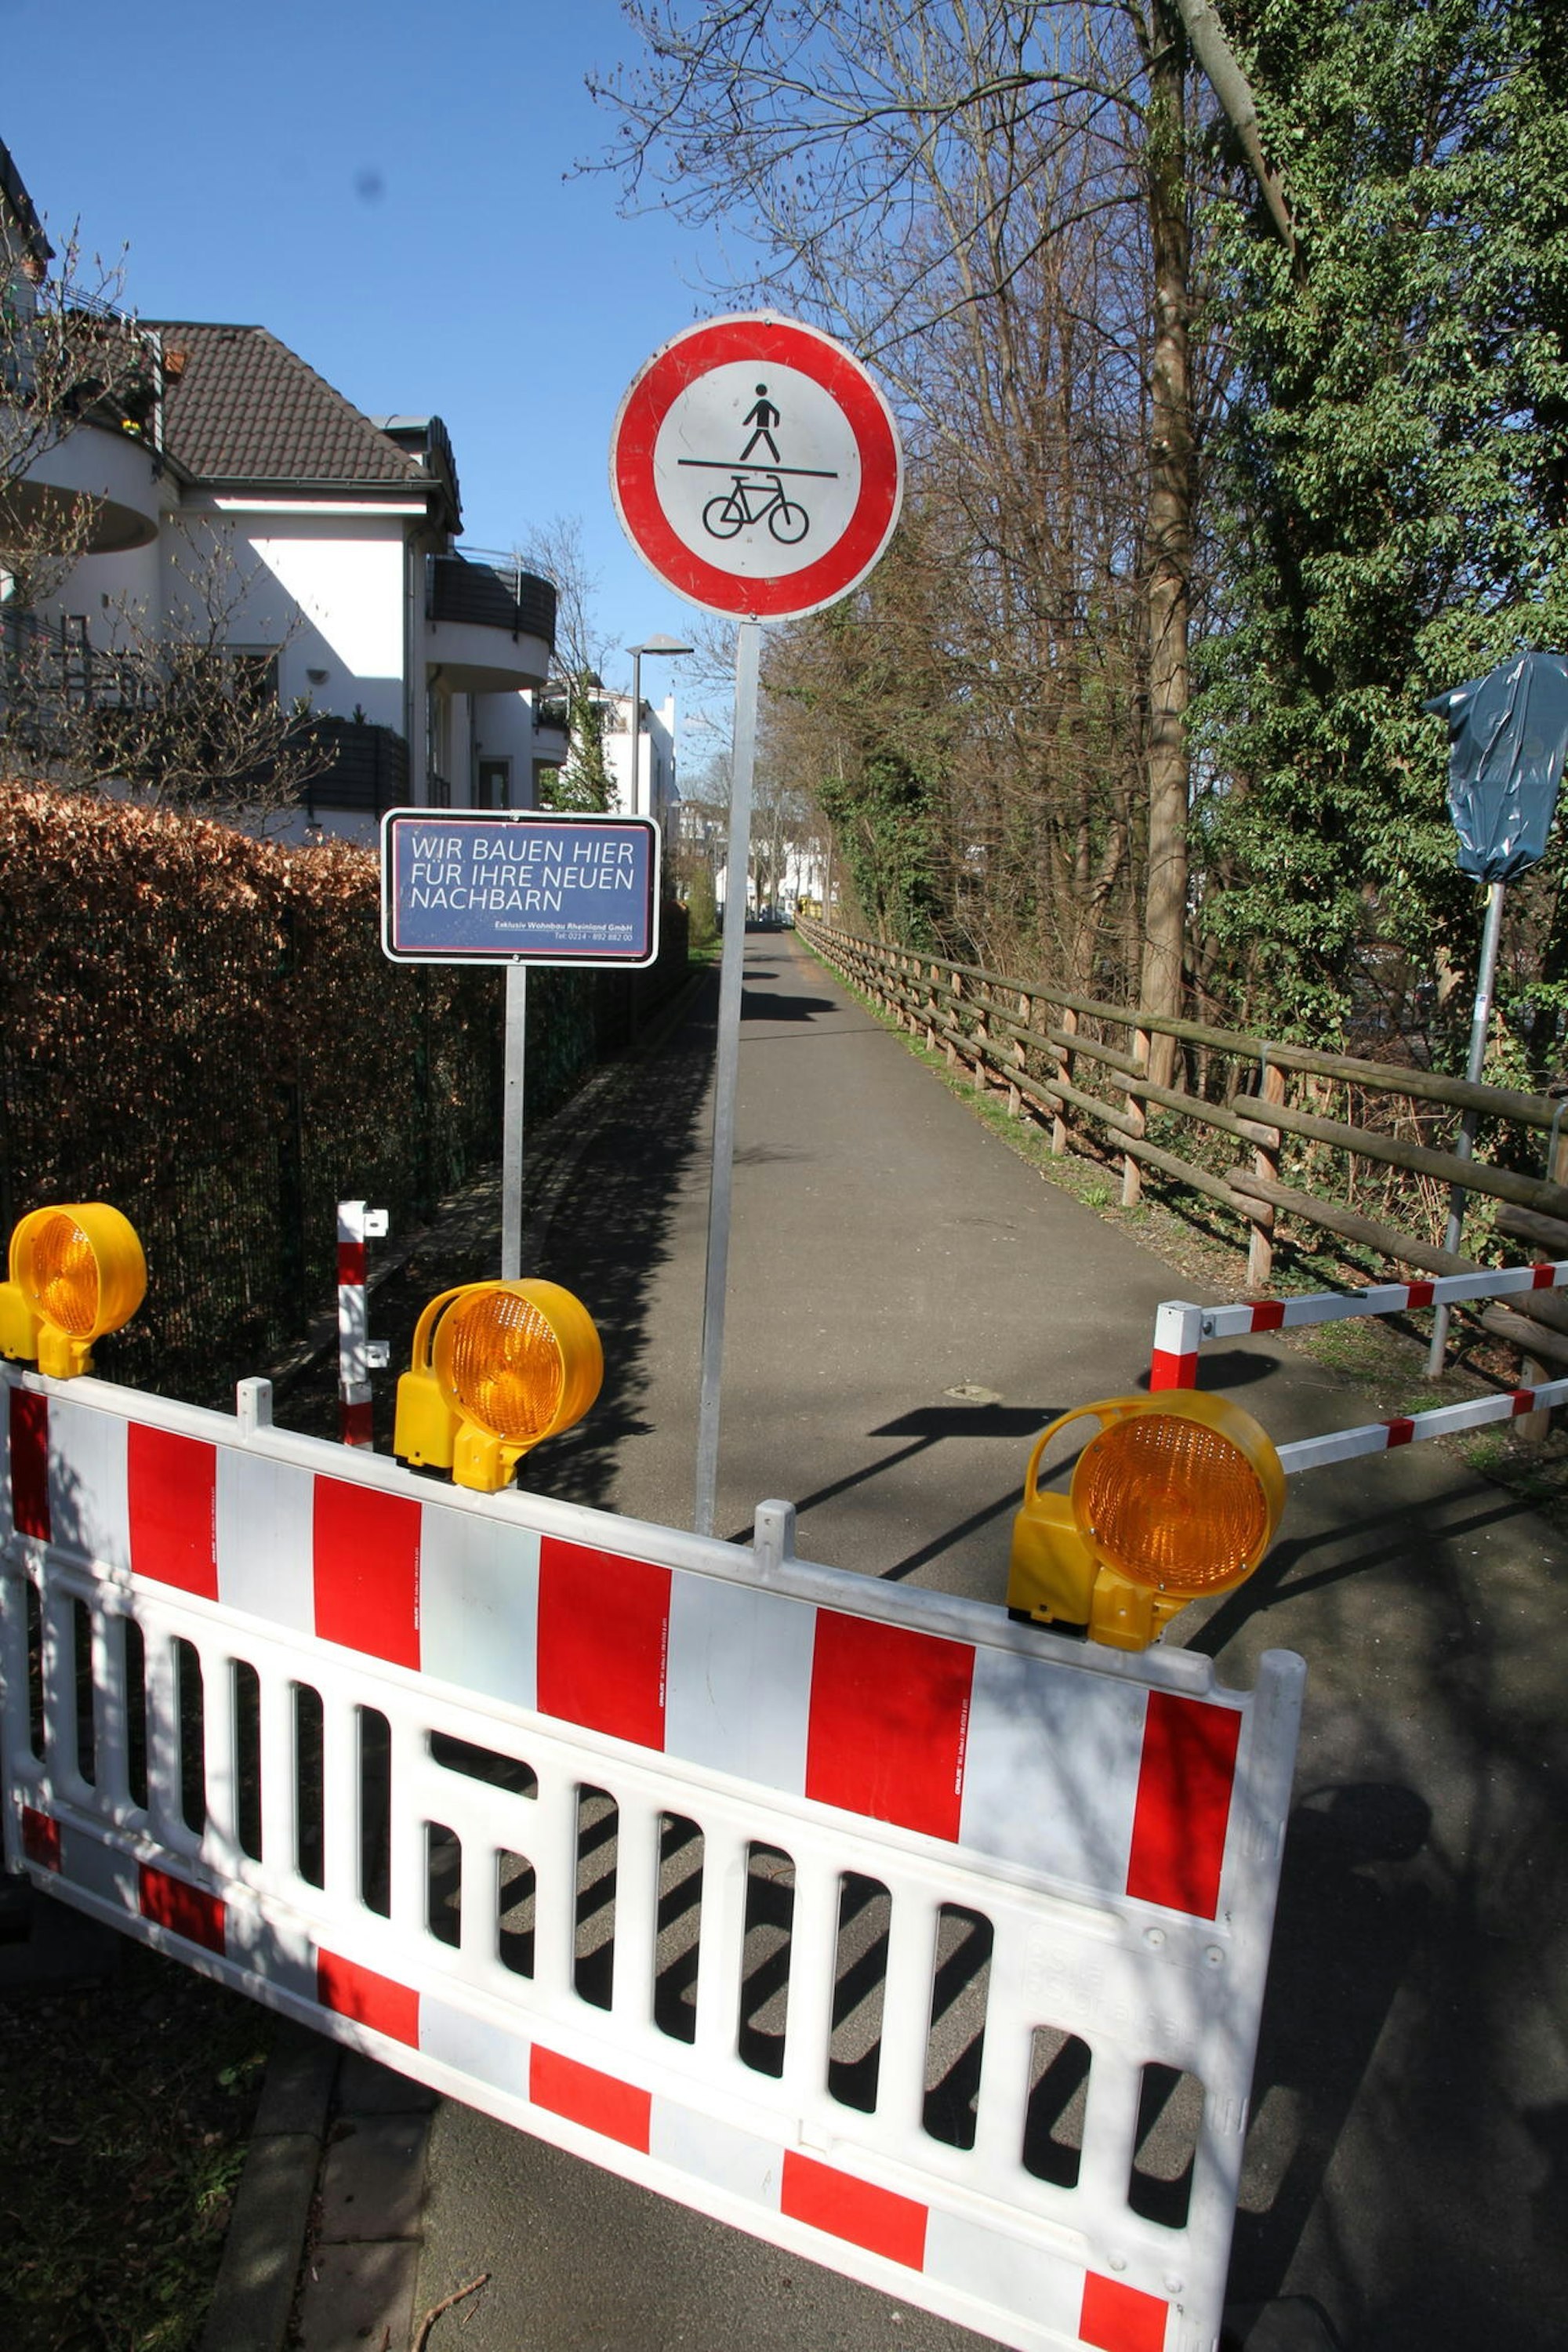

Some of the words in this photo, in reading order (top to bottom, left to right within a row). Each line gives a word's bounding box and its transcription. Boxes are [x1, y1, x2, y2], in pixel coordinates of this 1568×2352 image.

[412, 837, 463, 859] WIR
[472, 838, 564, 862] BAUEN
[573, 841, 634, 864] HIER
[411, 858, 462, 885] FÜR
[472, 864, 533, 887] IHRE
[542, 866, 634, 890] NEUEN
[411, 887, 563, 912] NACHBARN
[495, 920, 526, 929] Exklusiv
[527, 921, 565, 930] Wohnbau
[567, 922, 607, 931] Rheinland
